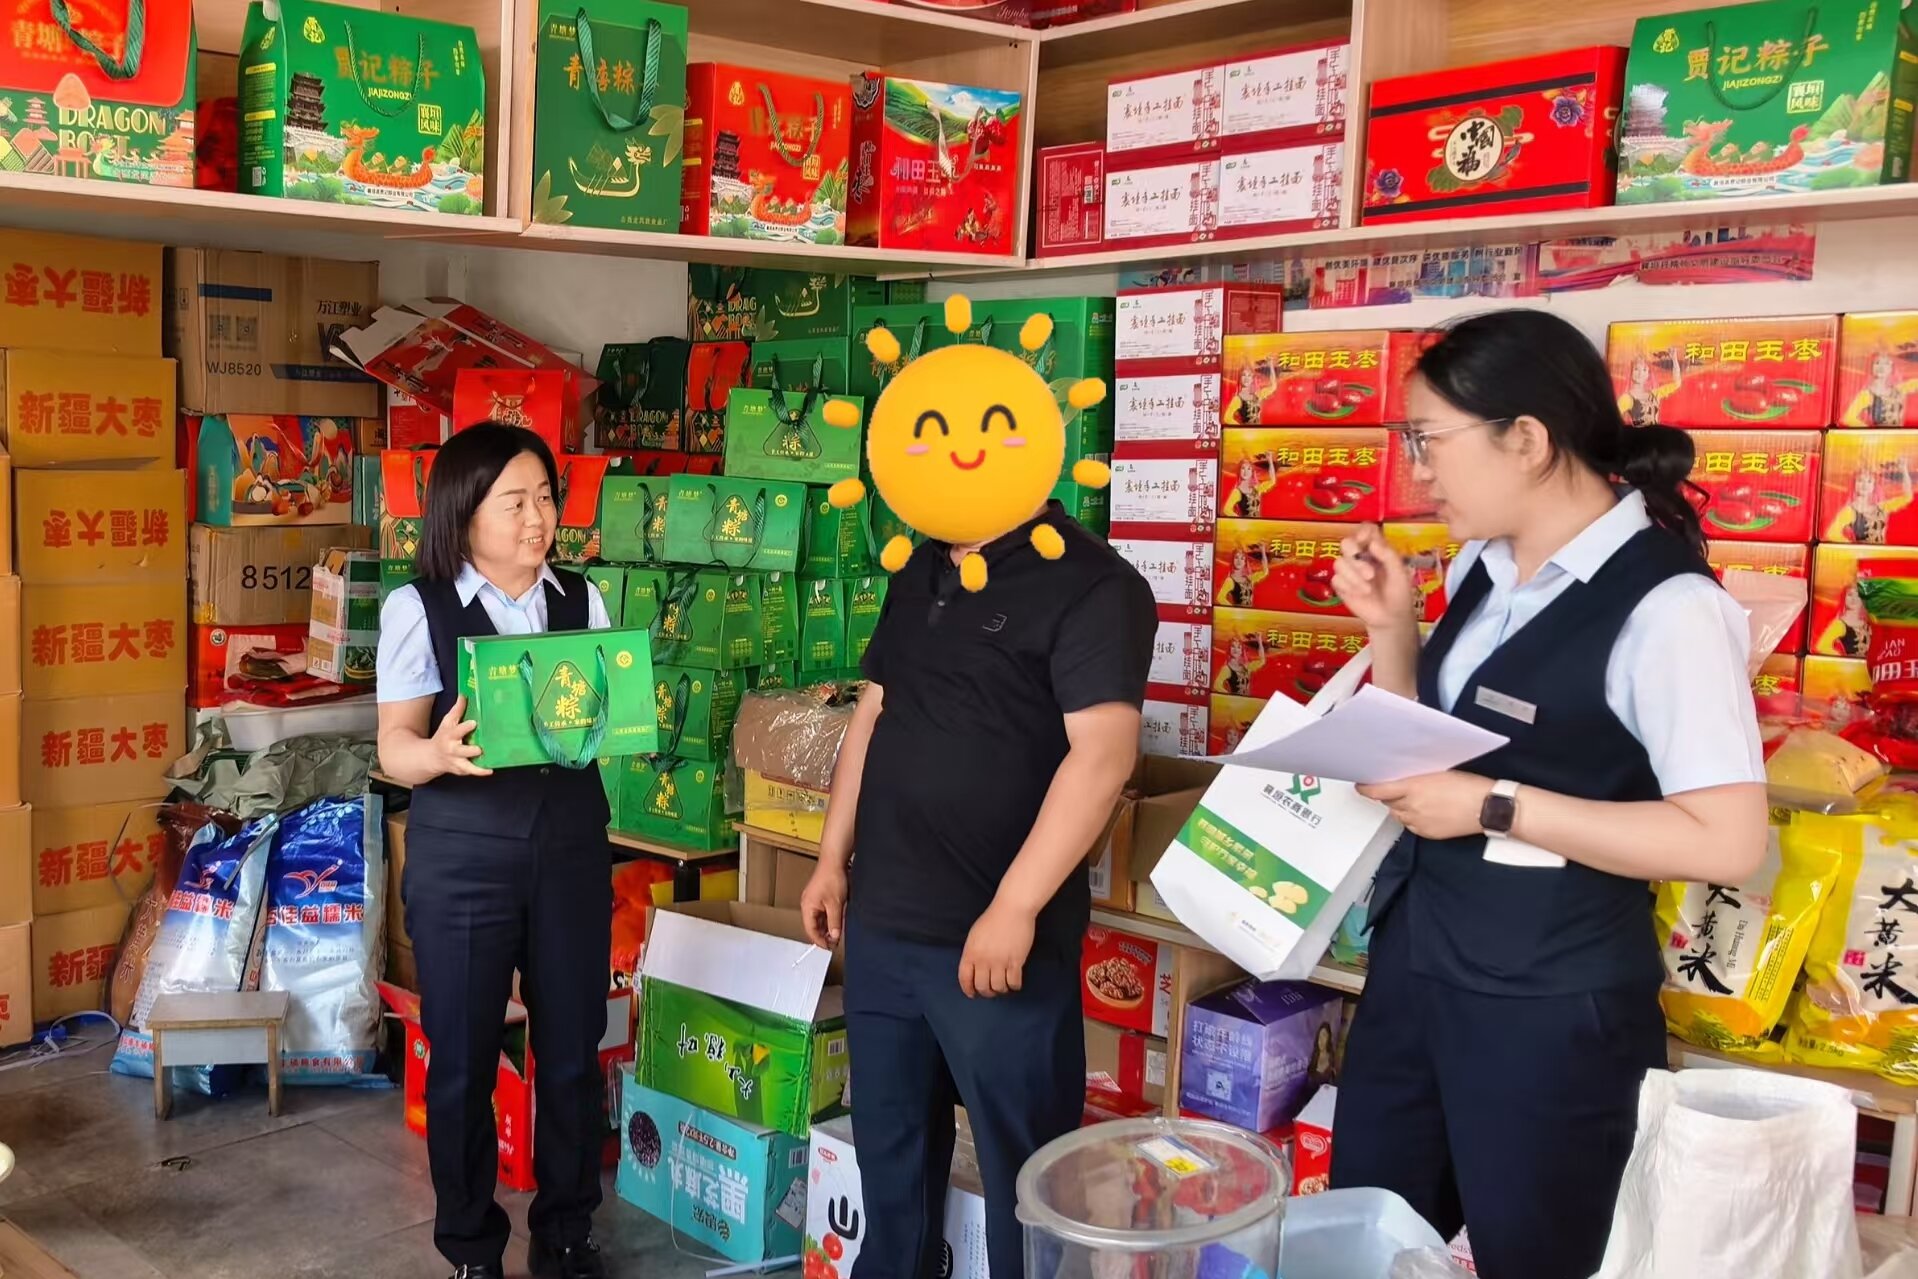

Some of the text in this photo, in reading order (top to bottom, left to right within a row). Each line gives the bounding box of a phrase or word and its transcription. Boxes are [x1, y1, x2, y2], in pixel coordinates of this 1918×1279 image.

[1683, 34, 1829, 82] 贾记粽子
[5, 263, 151, 317] 新疆大枣
[1278, 350, 1378, 369] 和田玉枣
[1684, 339, 1823, 362] 和田玉枣
[207, 360, 262, 377] WJ8520
[18, 389, 163, 438] 新疆大枣
[1277, 447, 1377, 466] 和田玉枣
[1694, 452, 1806, 474] 田玉枣
[42, 508, 169, 548] 新疆大枣
[1270, 539, 1342, 559] 和田玉
[241, 565, 311, 590] 8512
[31, 617, 175, 667] 新疆大枣
[1267, 629, 1366, 654] 和田玉枣
[41, 722, 169, 769] 新疆大枣
